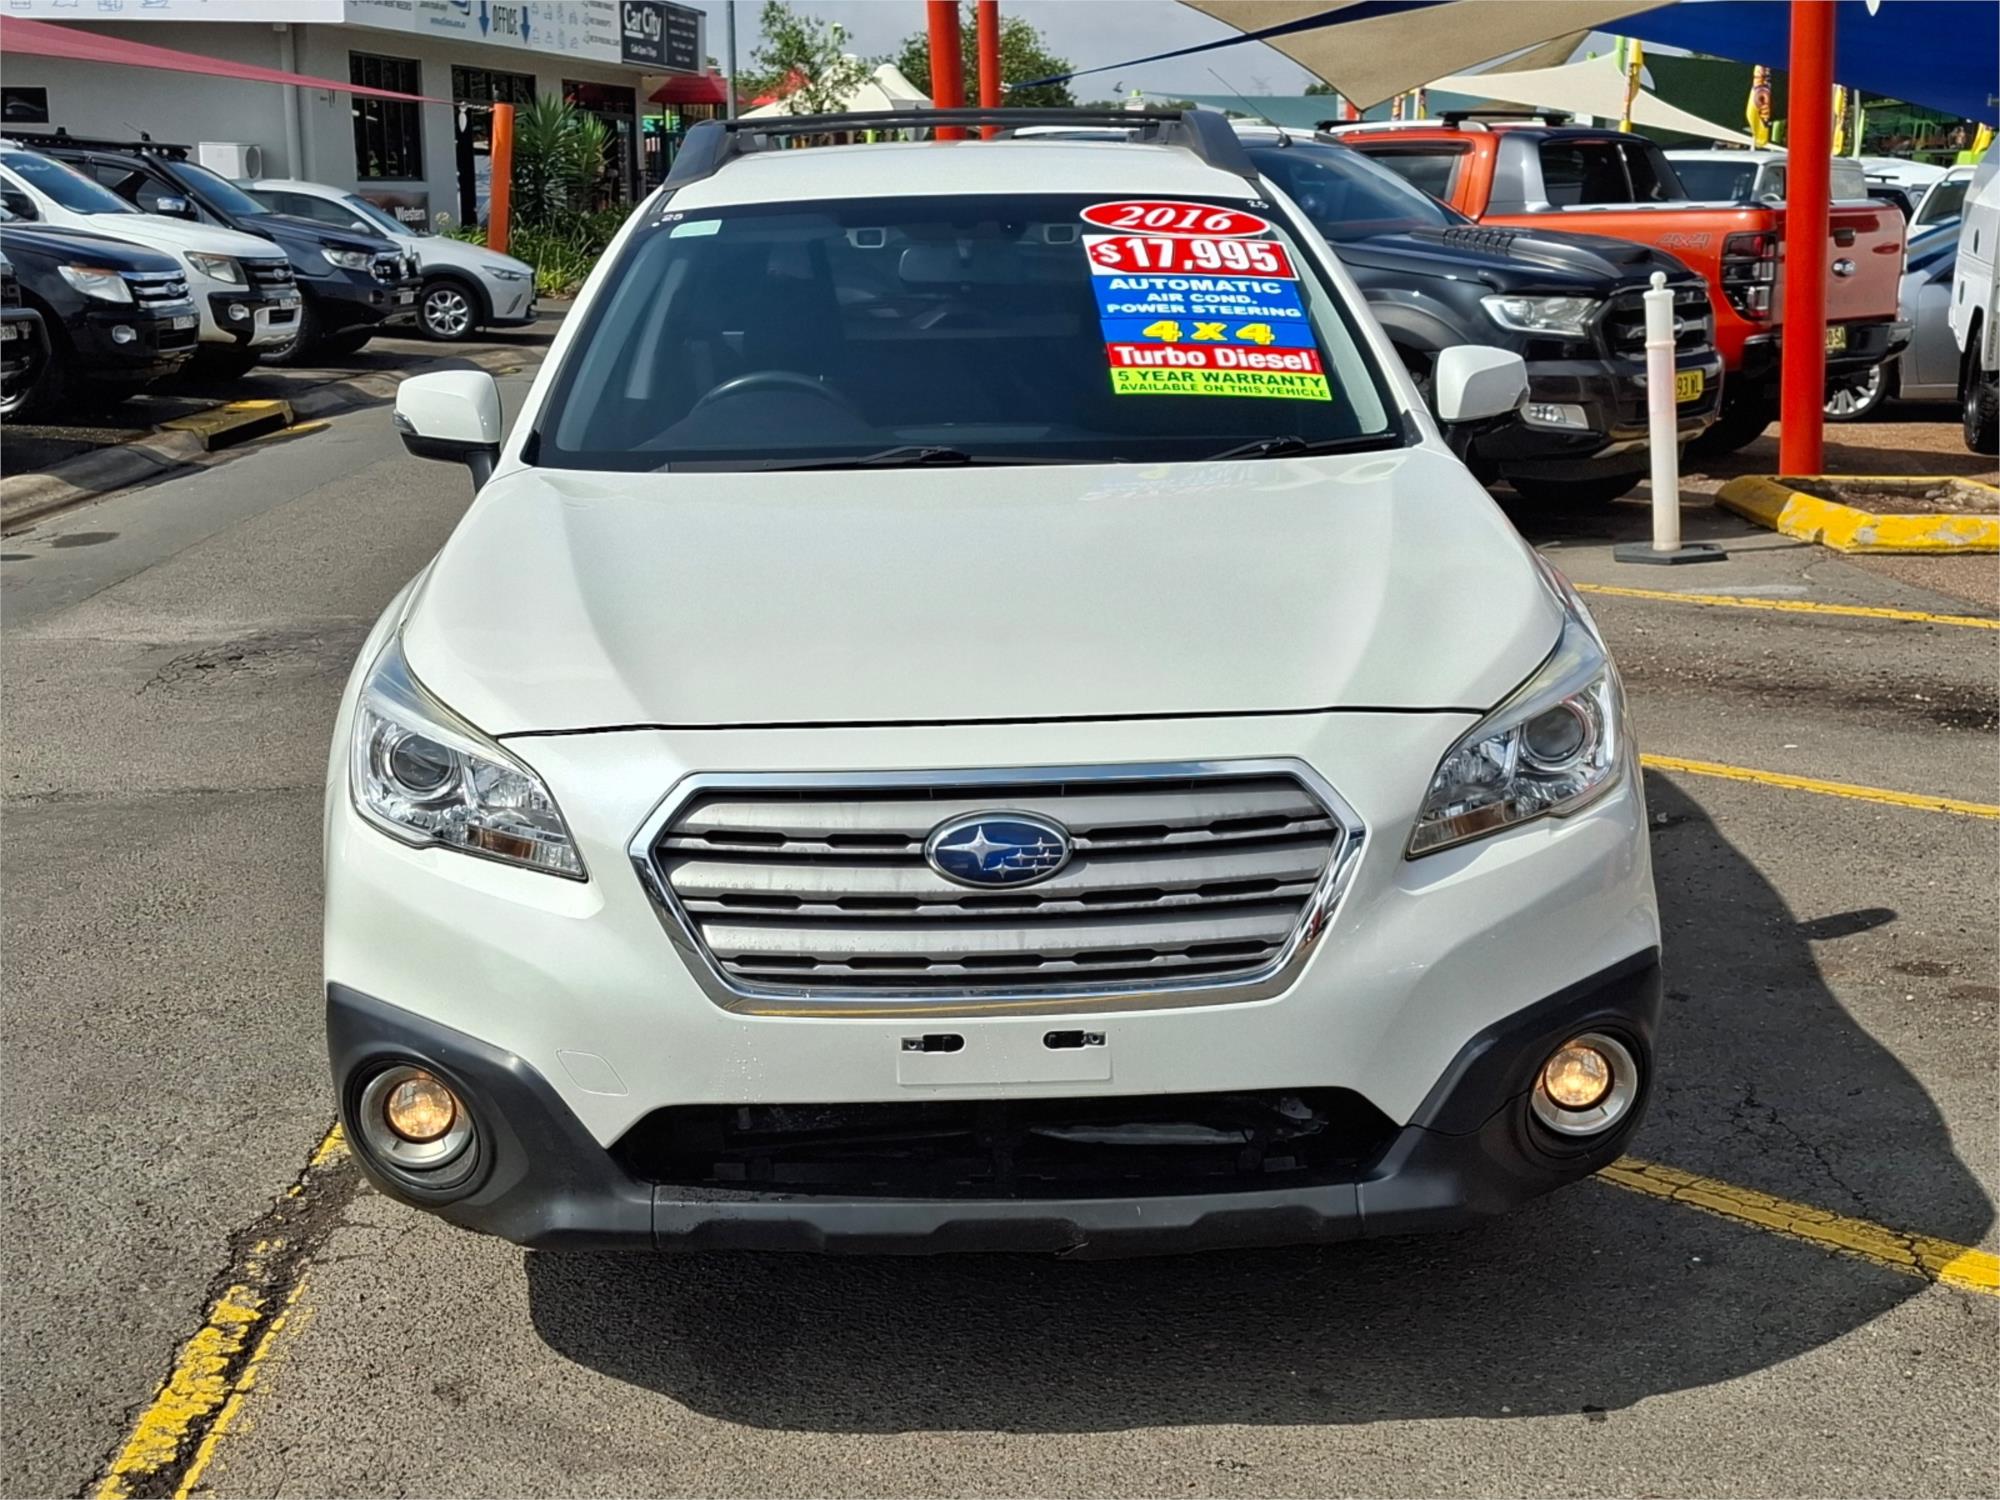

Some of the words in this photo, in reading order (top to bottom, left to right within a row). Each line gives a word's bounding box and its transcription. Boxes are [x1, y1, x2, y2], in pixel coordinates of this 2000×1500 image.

[1111, 206, 1239, 231] 2016
[1109, 278, 1282, 294] AUTOMATIC
[1147, 293, 1184, 302] AIR
[1189, 293, 1258, 305] COND.
[1106, 303, 1186, 313] POWER
[1191, 304, 1302, 318] STEERING
[1113, 346, 1206, 366] Turbo
[1214, 348, 1313, 371] Diesel
[1117, 370, 1129, 381] 5
[1137, 370, 1195, 382] YEAR
[1201, 371, 1323, 388] WARRANTY
[1120, 383, 1199, 391] AVAILABLE
[1203, 384, 1225, 393] ON
[1228, 385, 1262, 393] THIS
[1267, 387, 1329, 398] VEHICLE
